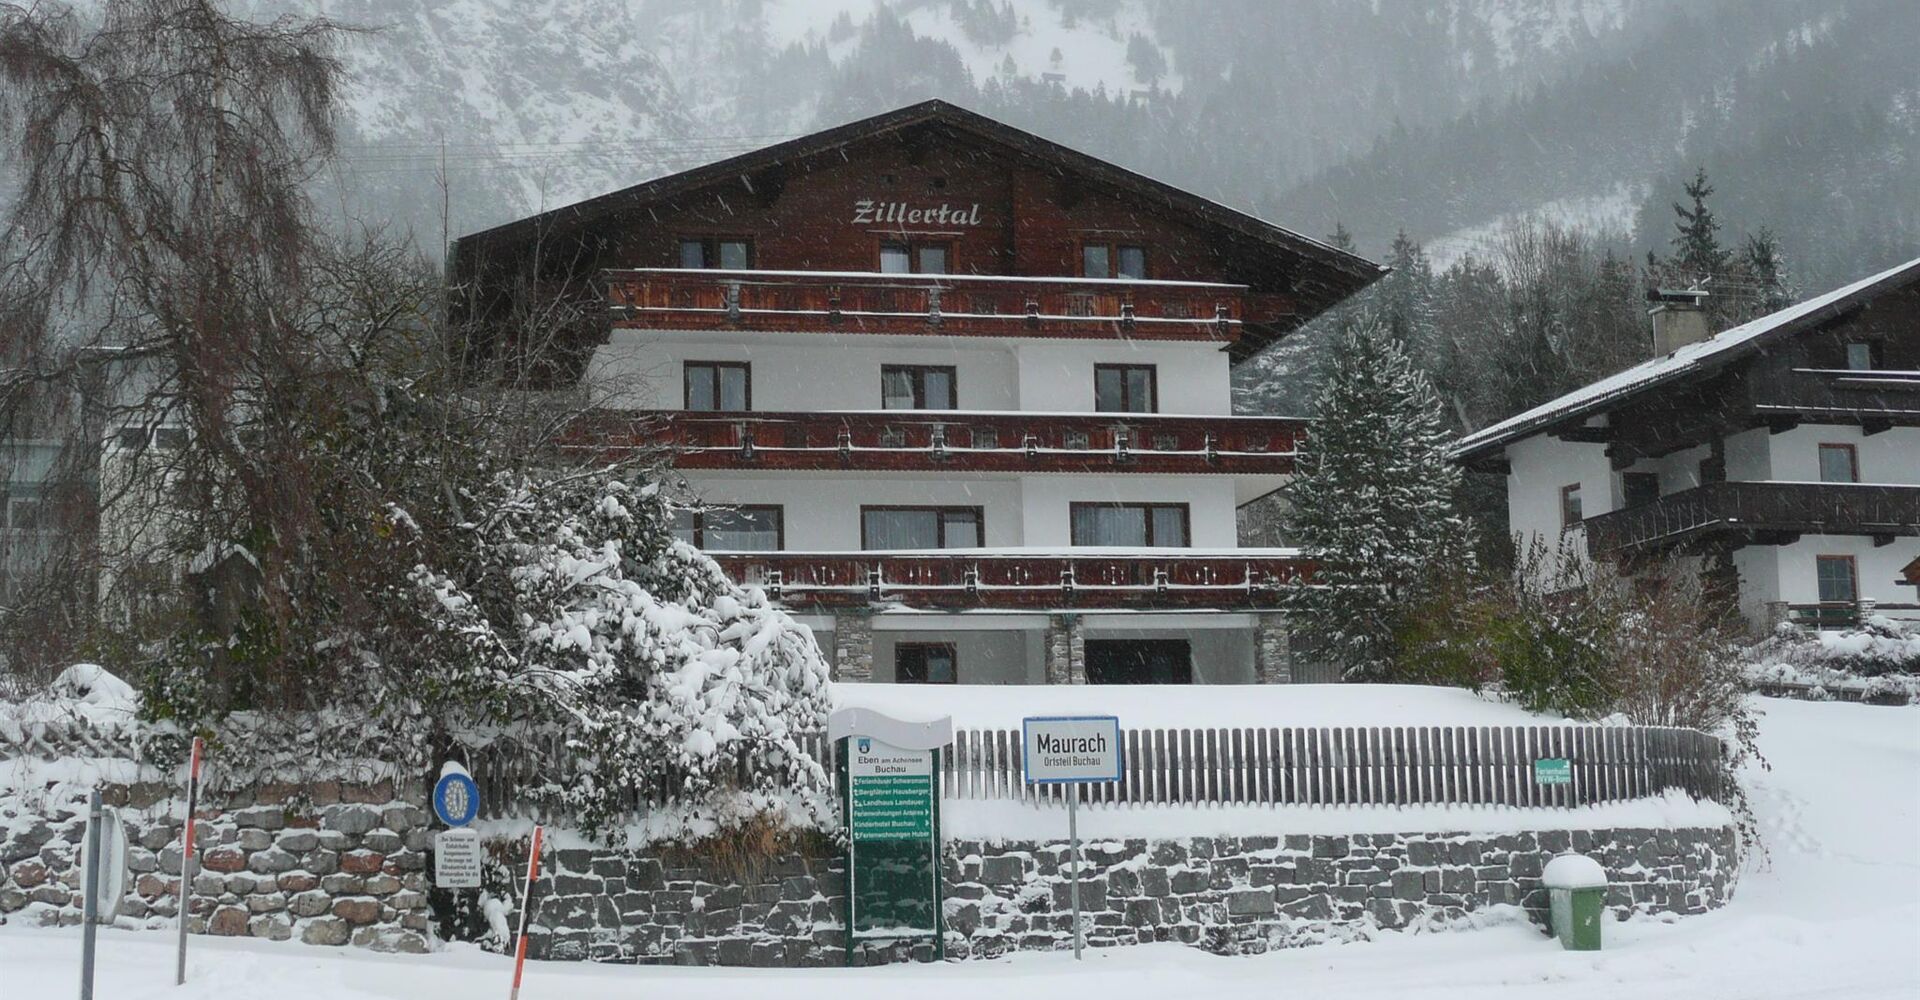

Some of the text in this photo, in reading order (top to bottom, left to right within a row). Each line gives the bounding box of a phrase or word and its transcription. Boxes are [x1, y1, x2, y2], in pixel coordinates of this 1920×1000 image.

[851, 198, 980, 226] Zillertal
[1037, 732, 1106, 754] Maurach
[858, 756, 879, 764] Eben
[1044, 756, 1101, 767] Ortsteil Buchau
[875, 765, 907, 773] Buchau
